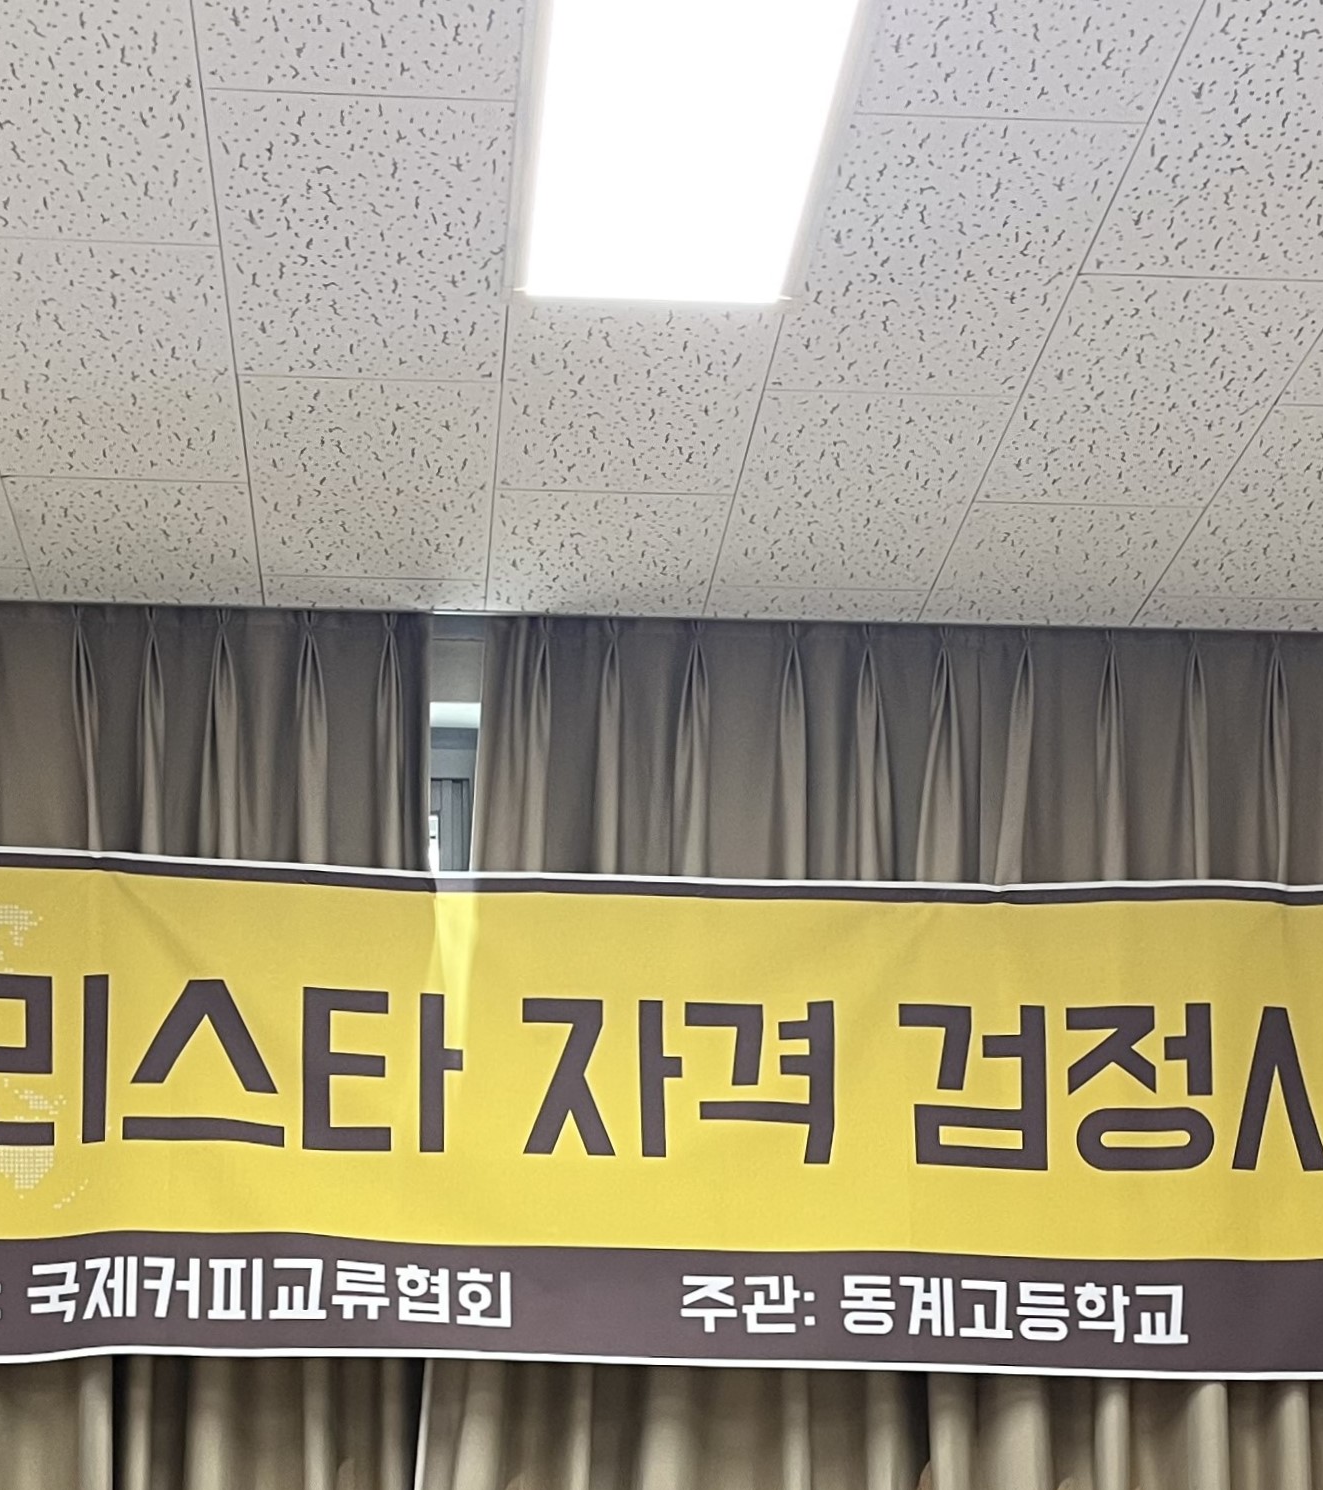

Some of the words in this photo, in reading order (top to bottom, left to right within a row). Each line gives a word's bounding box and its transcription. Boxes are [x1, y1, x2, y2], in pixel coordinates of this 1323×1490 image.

[522, 997, 835, 1165] 자격
[26, 1256, 512, 1329] 국제커피교류협회
[679, 1274, 816, 1334] 주관:
[839, 1274, 1190, 1344] 동계고등학교
